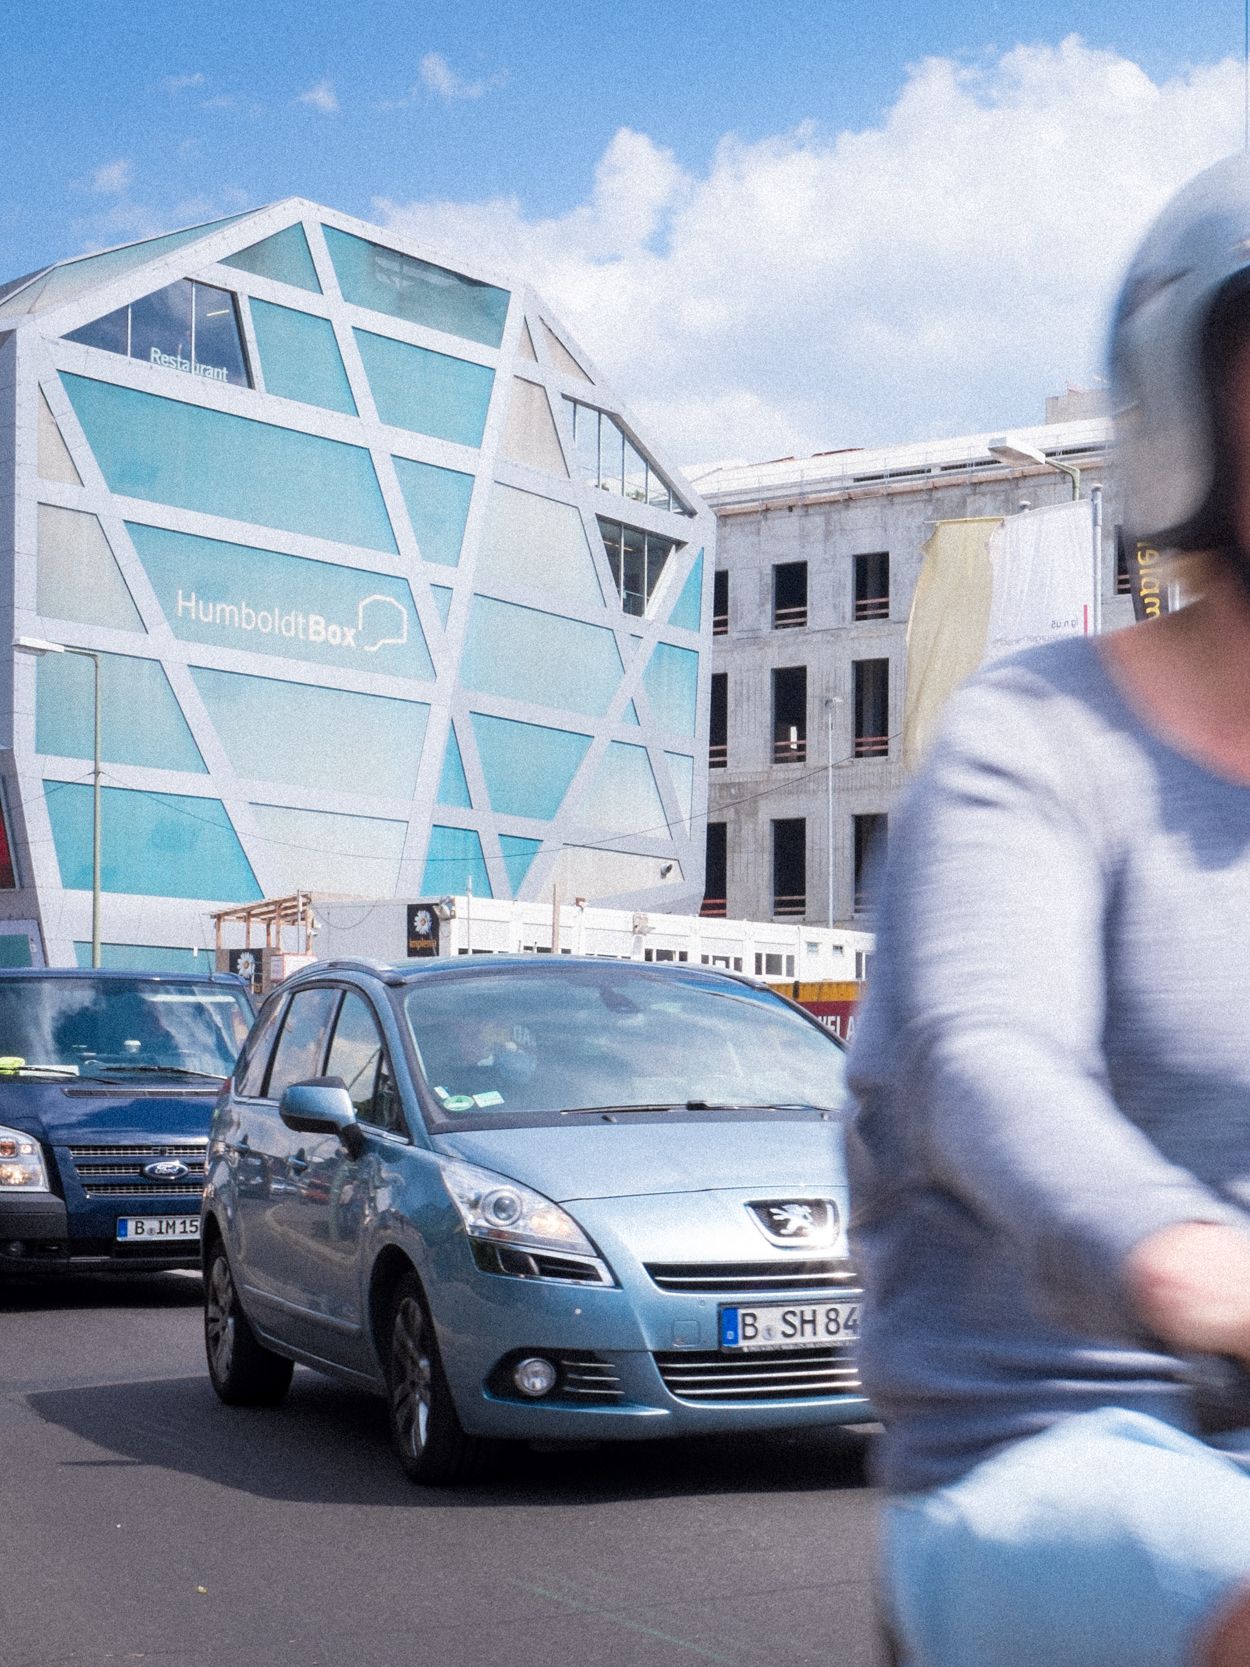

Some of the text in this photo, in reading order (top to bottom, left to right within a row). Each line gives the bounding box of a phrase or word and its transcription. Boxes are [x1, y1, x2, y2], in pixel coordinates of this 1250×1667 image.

[150, 346, 229, 382] Restaurant
[176, 589, 357, 648] HumboldtBox
[134, 1219, 199, 1235] B IM 15
[740, 1304, 858, 1341] B SH 84
